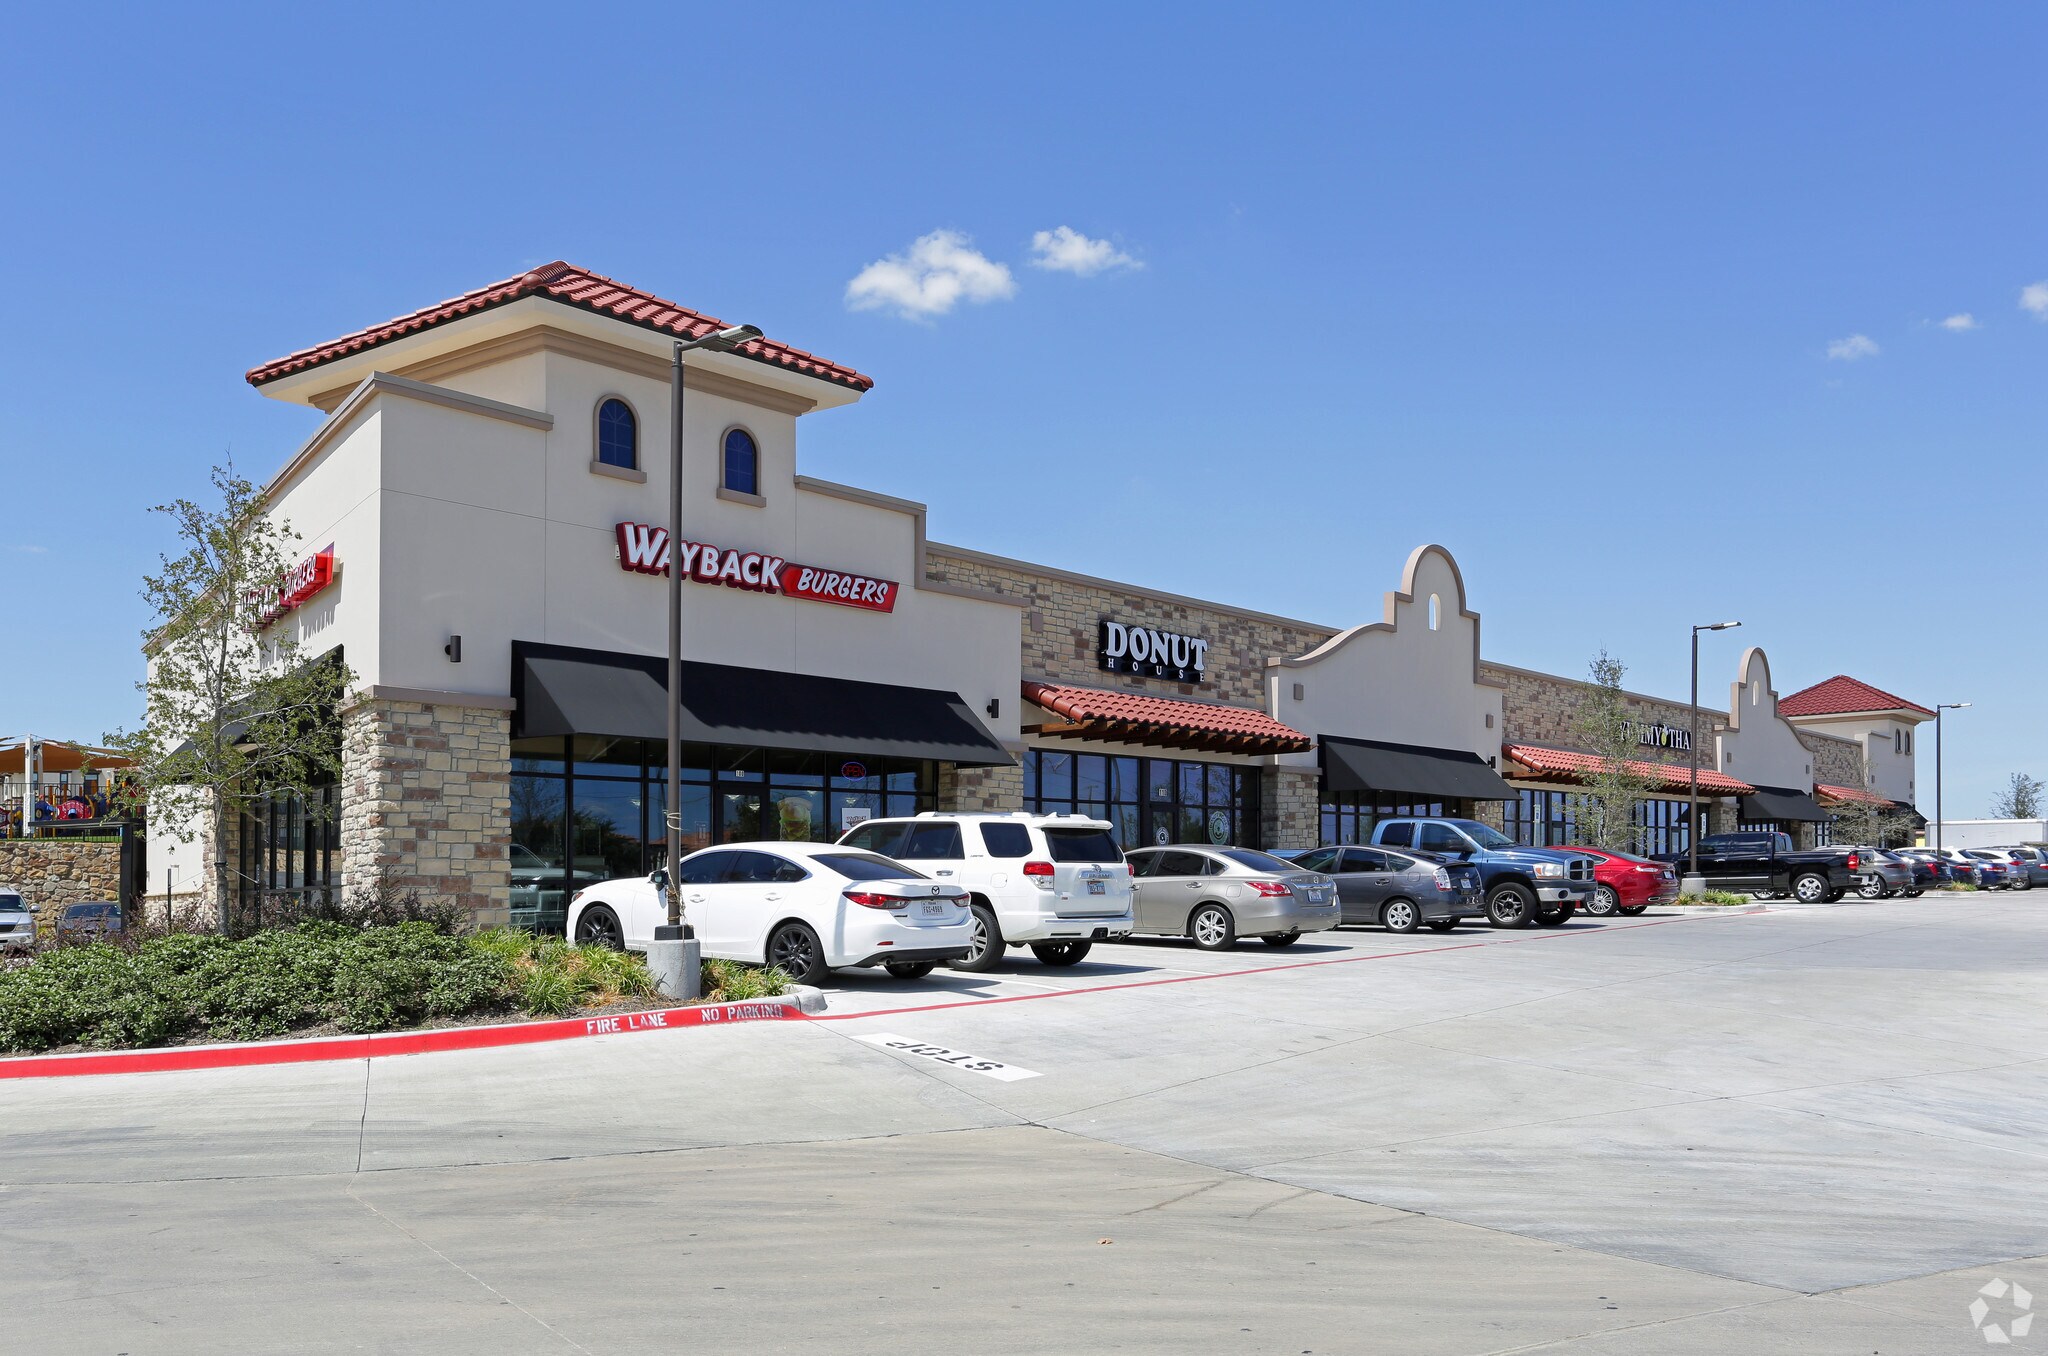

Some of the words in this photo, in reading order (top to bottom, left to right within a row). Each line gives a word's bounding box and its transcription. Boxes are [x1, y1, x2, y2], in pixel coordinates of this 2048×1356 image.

[619, 523, 783, 588] WAYBACK
[797, 568, 889, 604] BURGERS
[1106, 621, 1207, 671] DONUT
[1108, 657, 1205, 682] HOUSE
[586, 1017, 621, 1035] FIRE
[628, 1012, 667, 1030] LANE
[701, 1008, 720, 1023] NO
[727, 1004, 783, 1020] PARKING
[885, 1041, 1004, 1071] STOP
